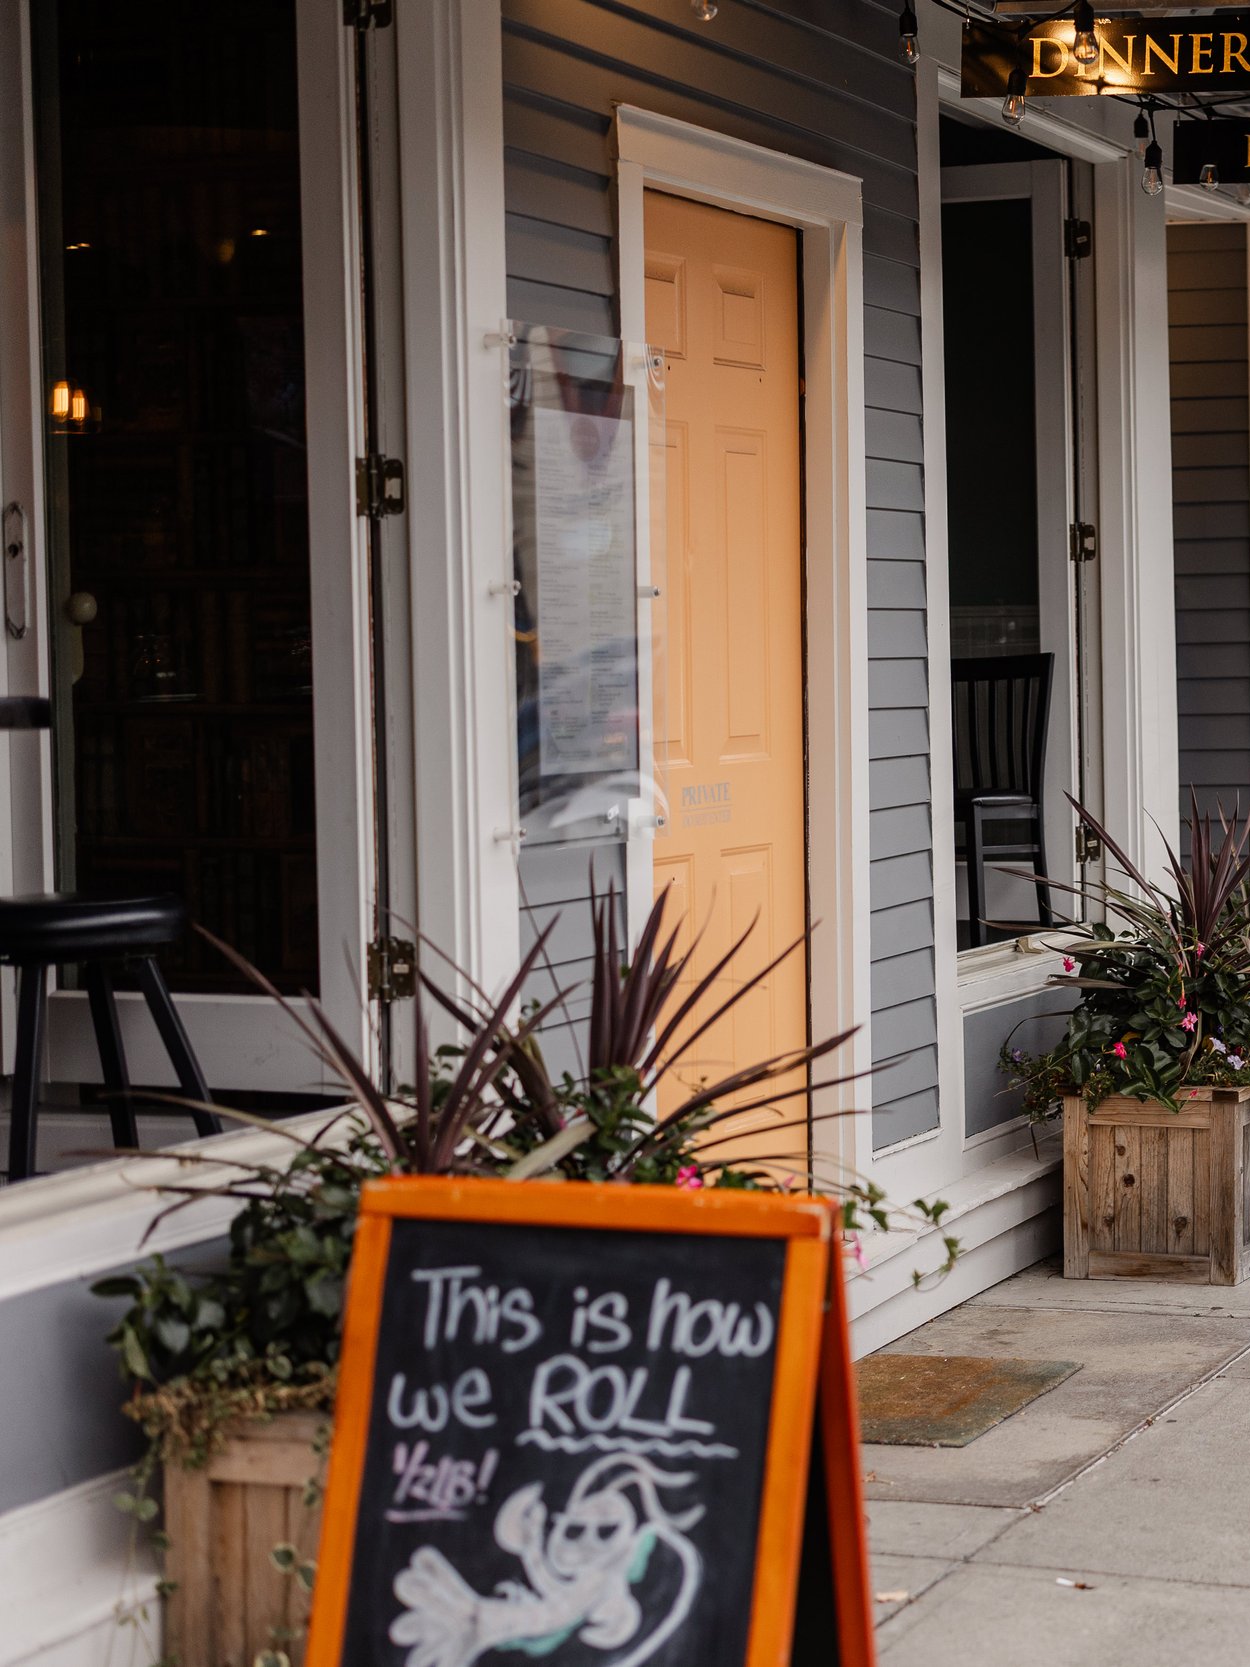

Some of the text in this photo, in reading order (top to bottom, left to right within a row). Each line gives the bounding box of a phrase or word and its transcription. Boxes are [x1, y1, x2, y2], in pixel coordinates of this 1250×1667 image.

[681, 781, 731, 808] PRIVATE
[411, 1265, 774, 1357] This is how
[387, 1353, 716, 1437] we ROLL
